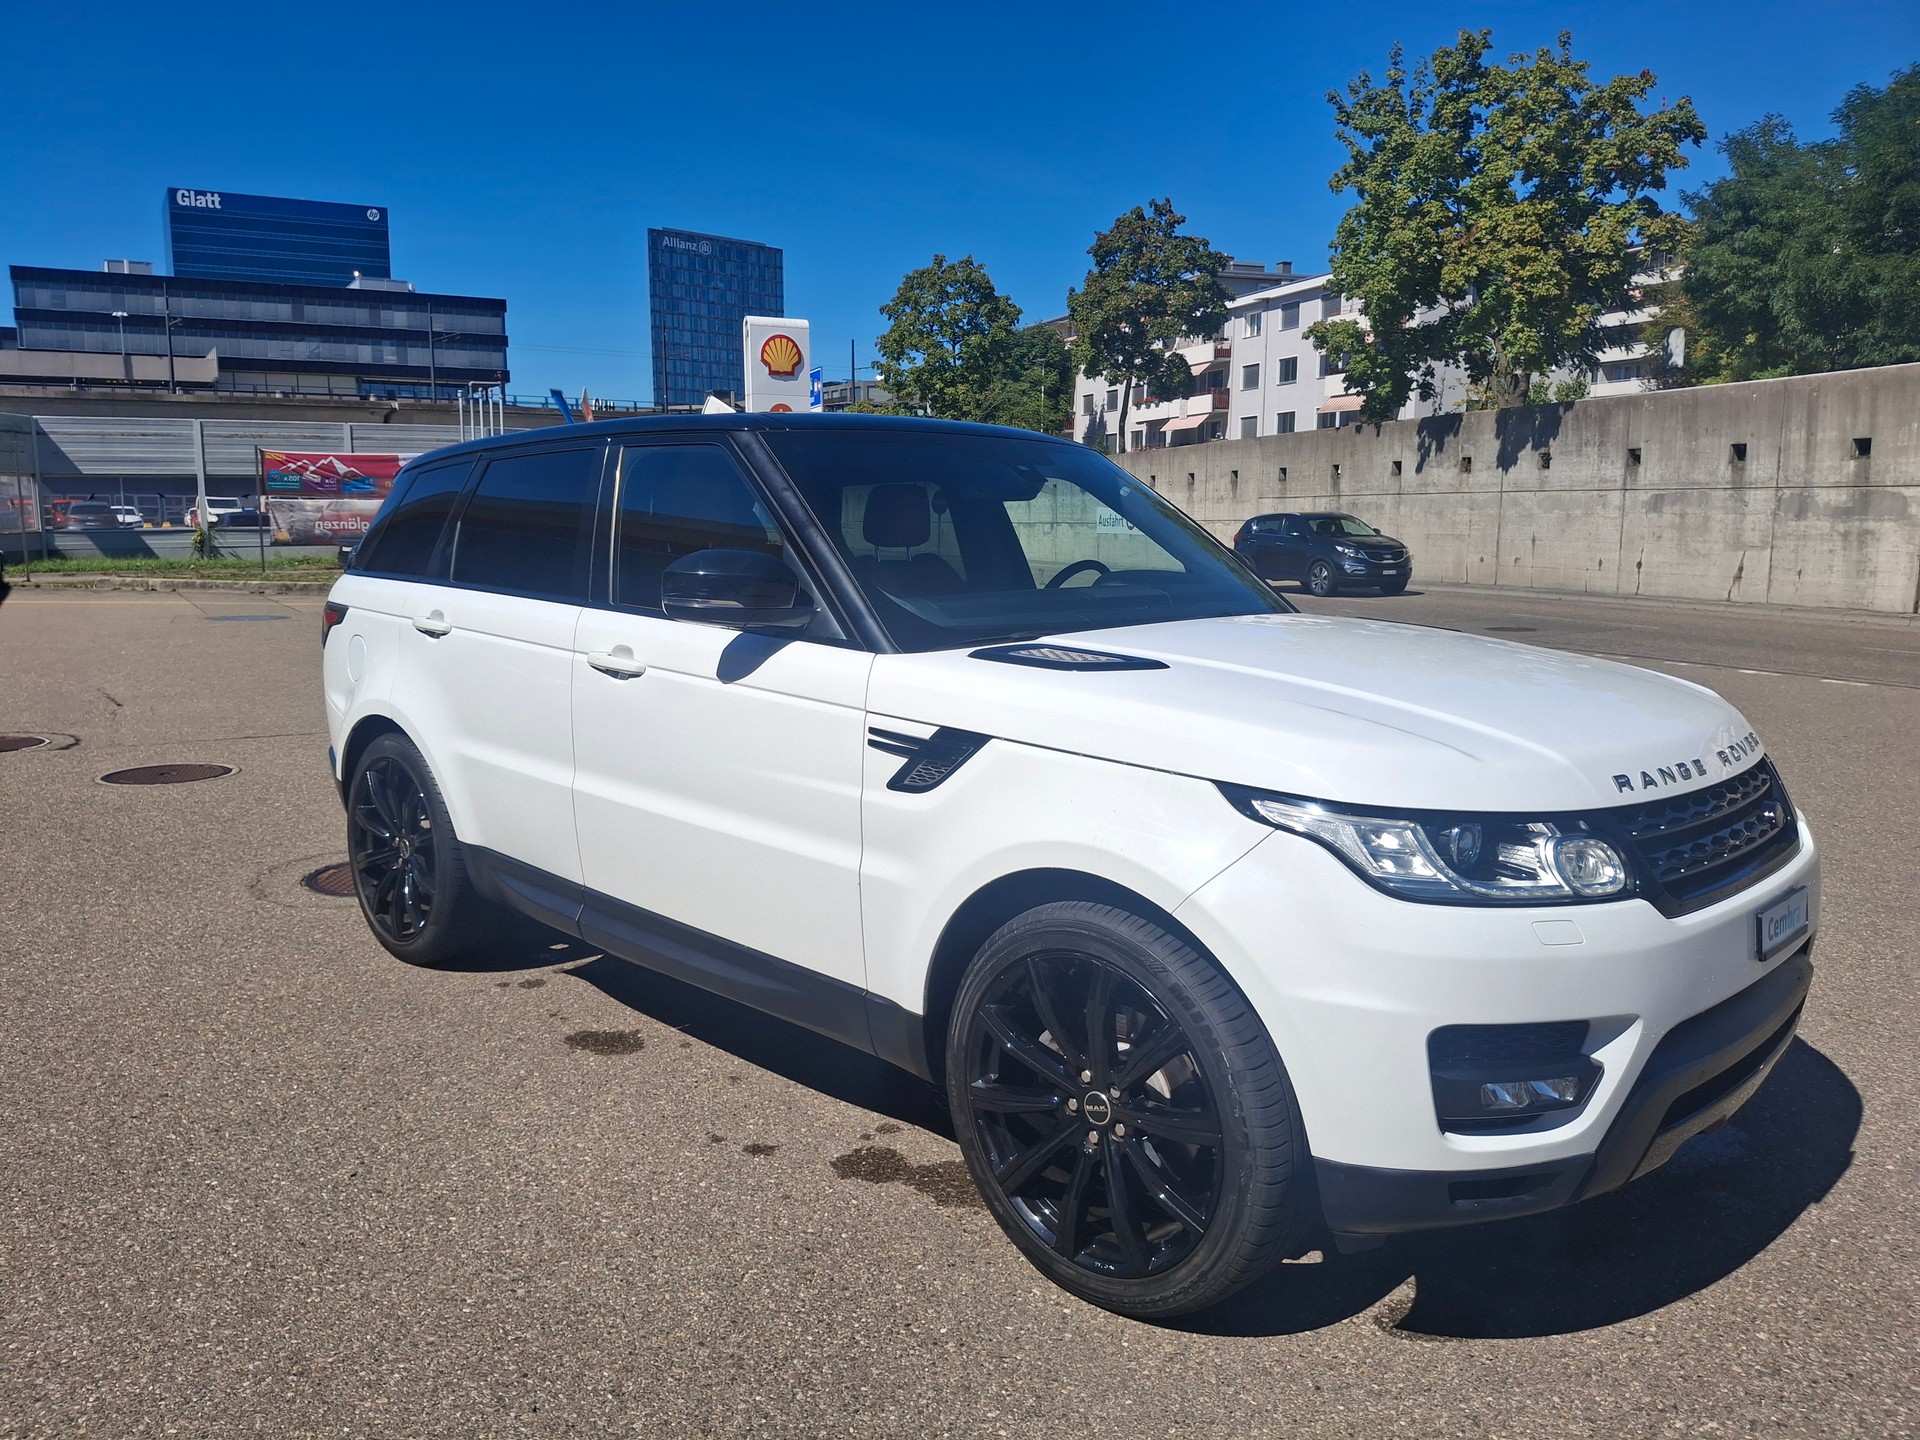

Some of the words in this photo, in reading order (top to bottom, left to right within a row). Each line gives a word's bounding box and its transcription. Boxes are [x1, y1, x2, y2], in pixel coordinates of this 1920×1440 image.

[176, 189, 222, 209] Glatt
[368, 209, 379, 221] hp
[662, 236, 698, 251] Allianz
[1098, 514, 1124, 527] Ausfahrt
[1611, 758, 1707, 794] RANGE
[1716, 732, 1760, 767] ROVER
[1086, 1104, 1108, 1112] MAK
